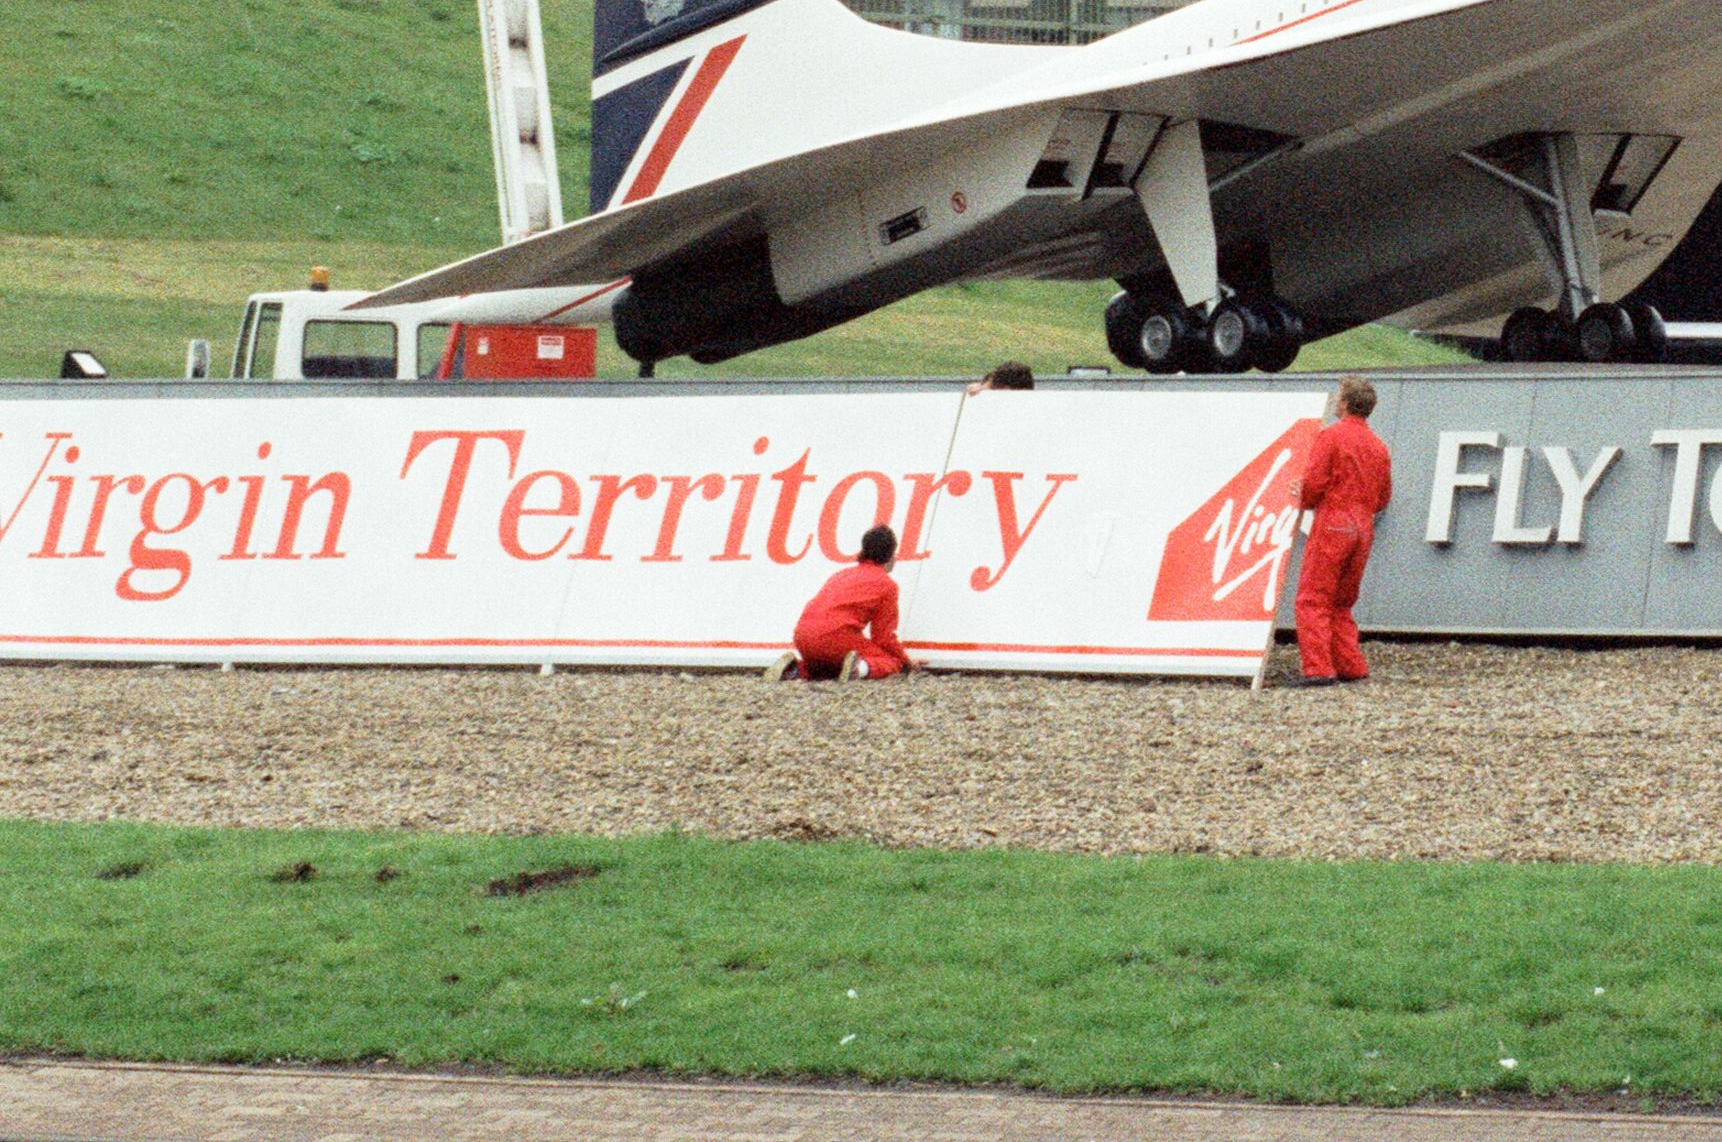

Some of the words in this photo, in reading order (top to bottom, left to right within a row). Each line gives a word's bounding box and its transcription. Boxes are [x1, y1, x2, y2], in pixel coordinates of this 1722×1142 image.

[400, 429, 1078, 592] Territory
[1204, 448, 1300, 611] Virg
[1425, 431, 1622, 547] FLY
